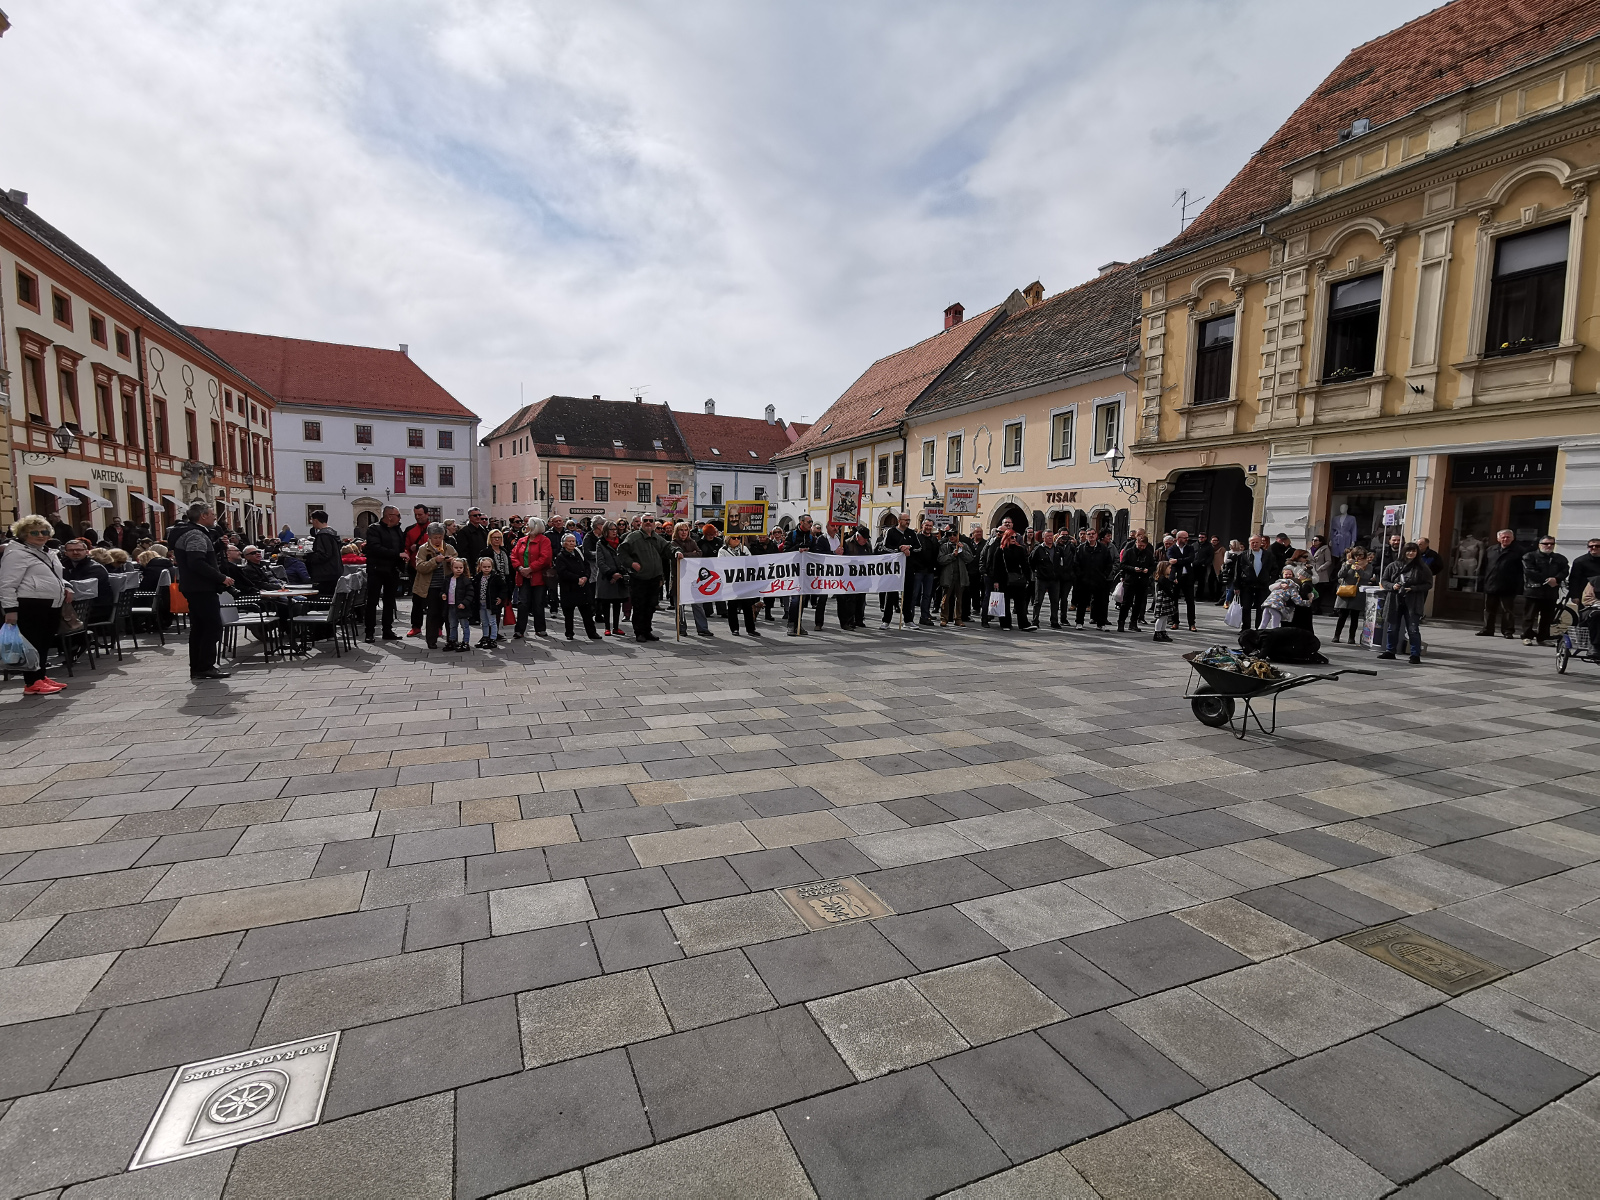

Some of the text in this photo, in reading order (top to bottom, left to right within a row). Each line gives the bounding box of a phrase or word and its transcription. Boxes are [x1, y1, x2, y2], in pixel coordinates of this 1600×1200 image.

[1346, 470, 1402, 481] JADRAN
[1470, 463, 1543, 475] JADRAN
[1046, 491, 1078, 504] TISAK
[724, 561, 901, 583] VARAŽDIN GRAD BAROKA
[763, 576, 856, 593] BEZ ČEHOKA
[182, 1043, 329, 1083] BAD RADKERSBURG
